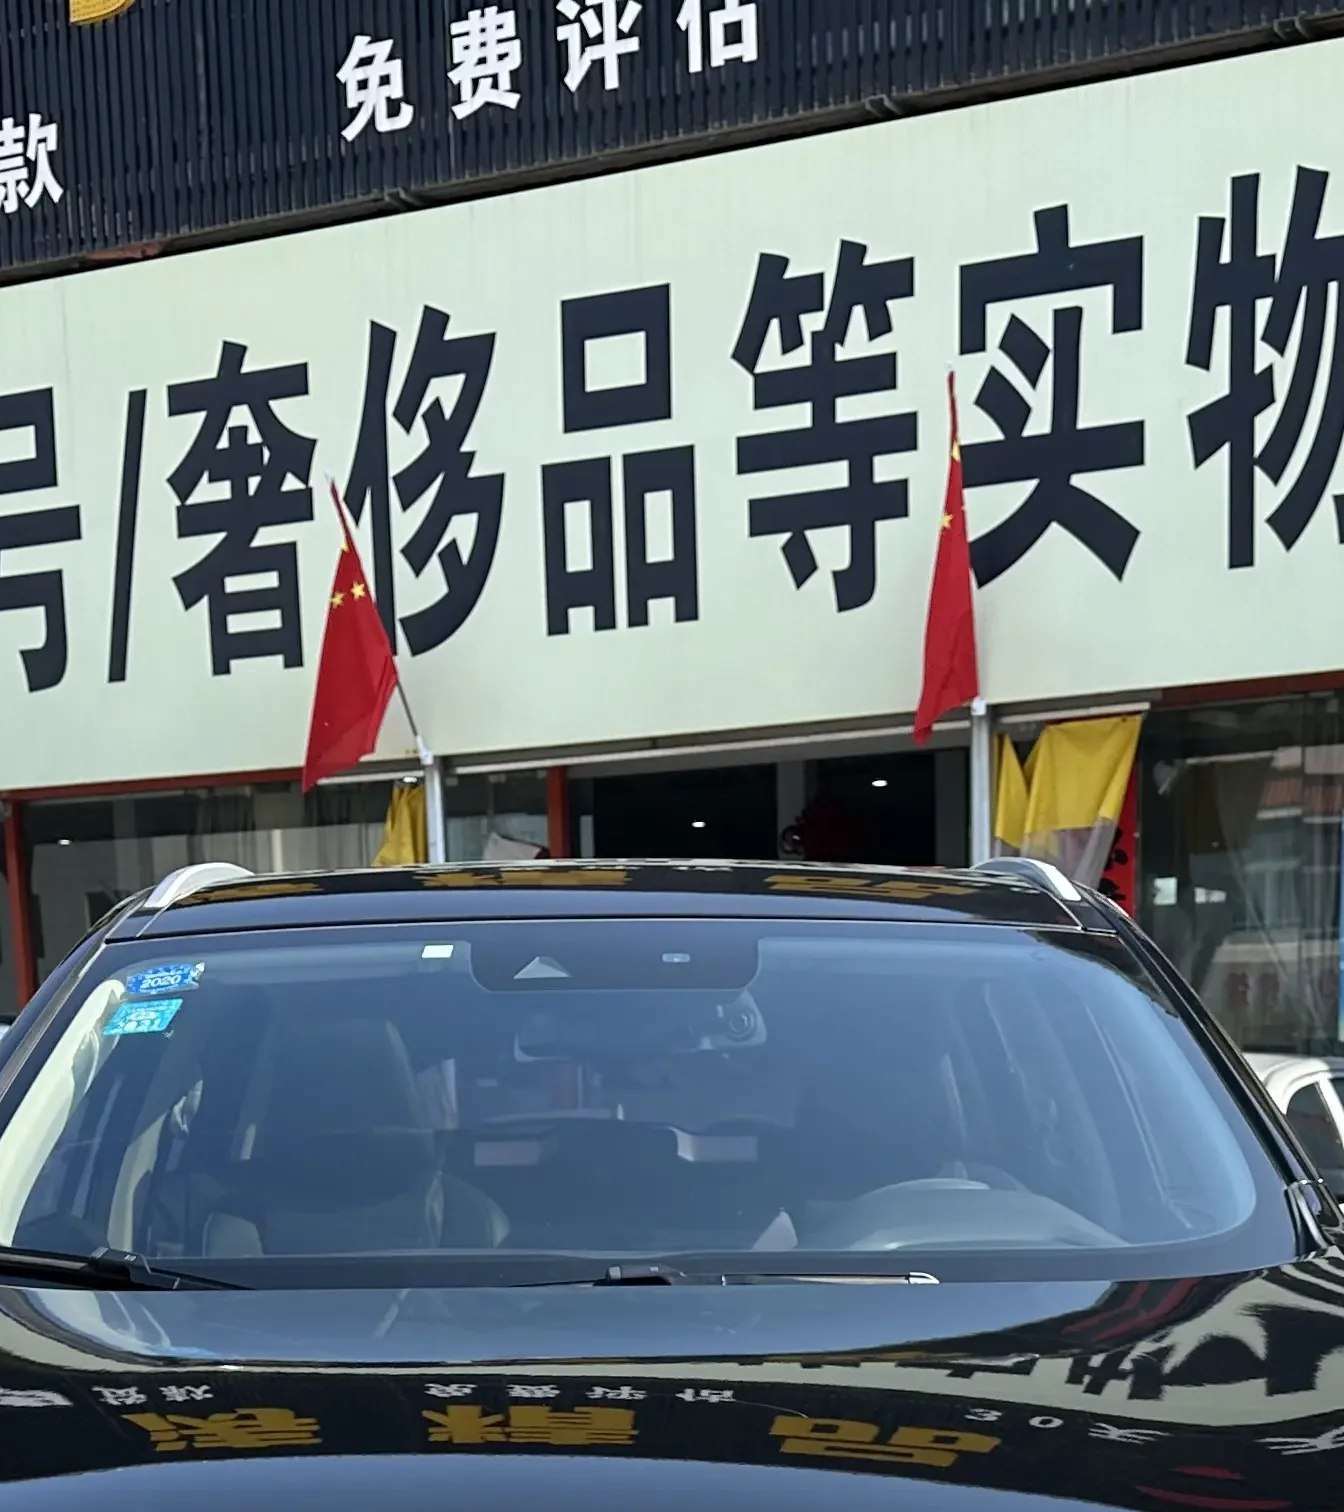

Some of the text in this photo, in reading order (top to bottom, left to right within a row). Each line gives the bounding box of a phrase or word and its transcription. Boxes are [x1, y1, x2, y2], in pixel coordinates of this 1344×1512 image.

[335, 0, 758, 141] 免费评估
[139, 974, 183, 989] 2020
